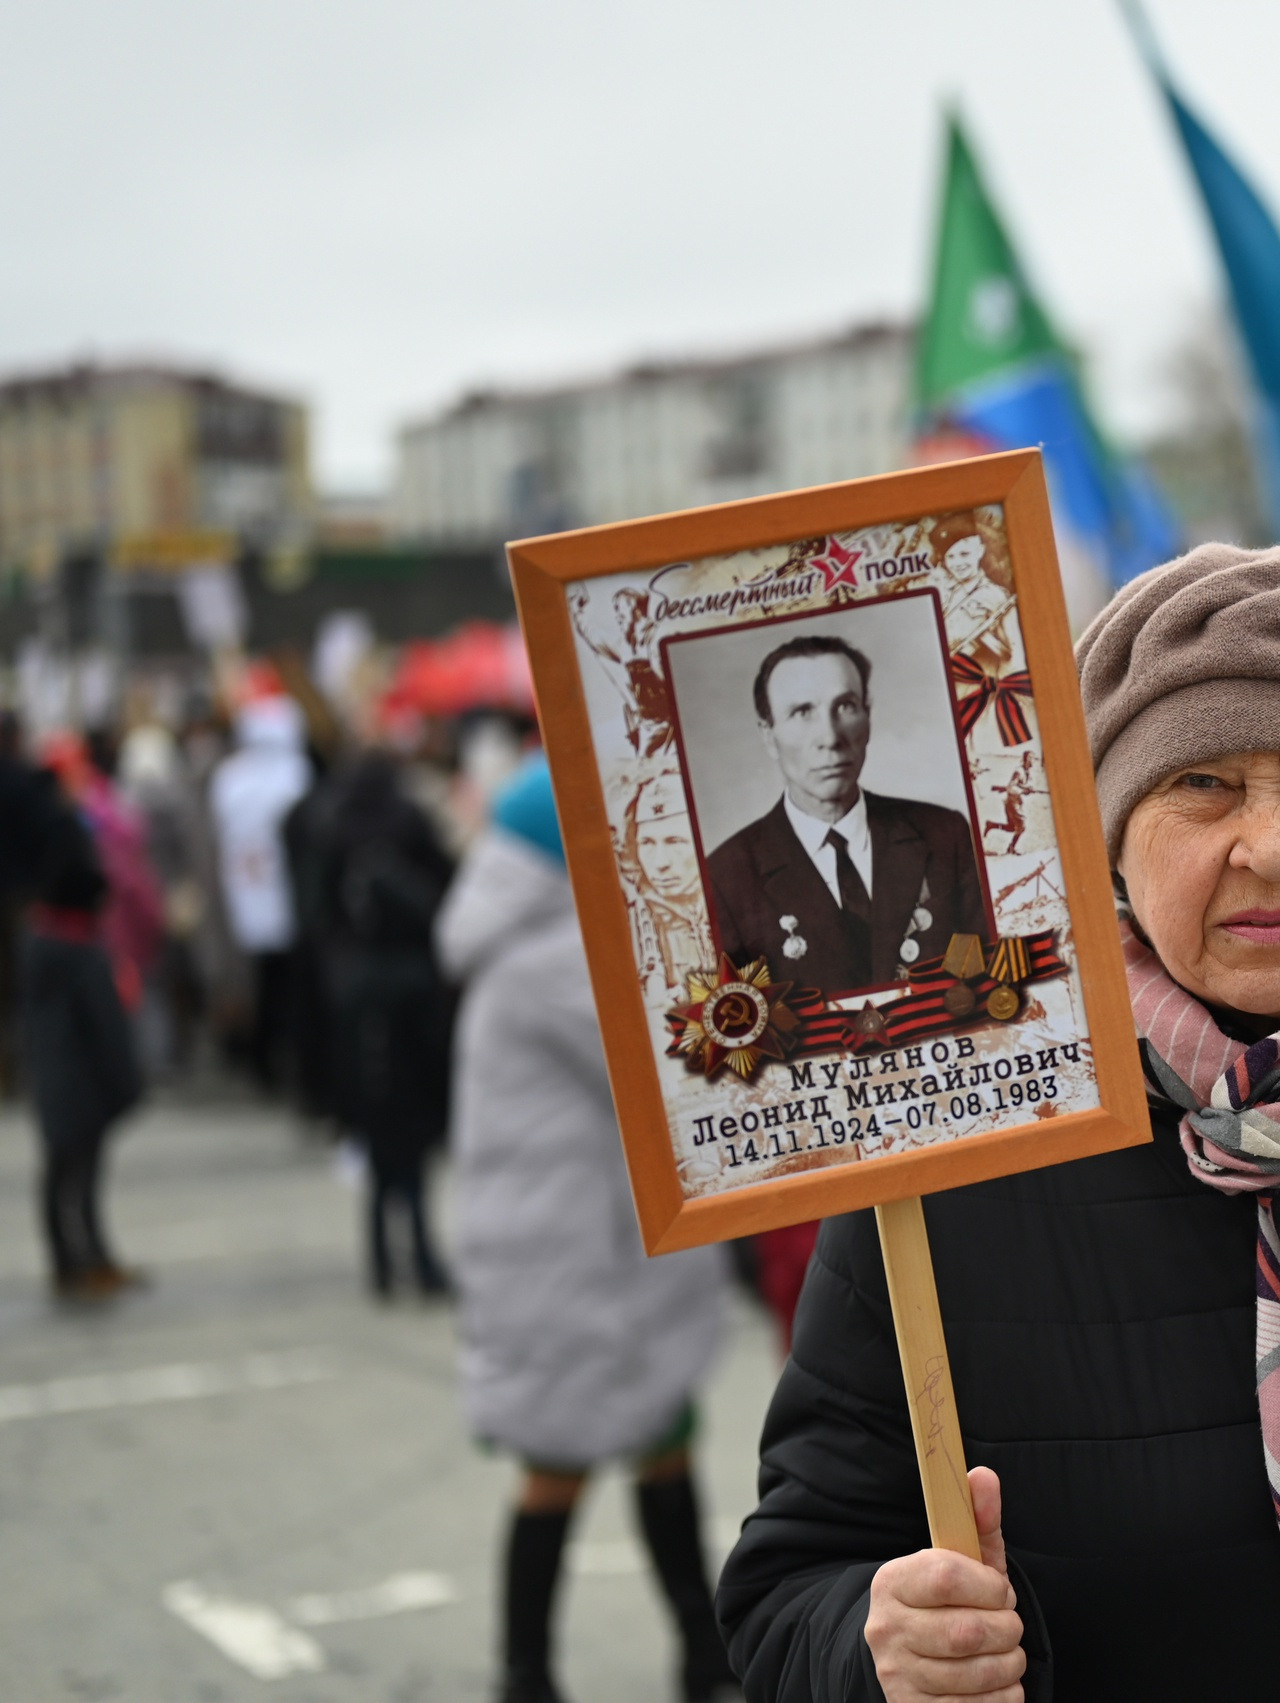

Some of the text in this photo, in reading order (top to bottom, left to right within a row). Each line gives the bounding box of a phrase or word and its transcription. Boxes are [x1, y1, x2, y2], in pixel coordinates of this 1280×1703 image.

[693, 1041, 1082, 1147] Леонид Михайлович
[789, 1036, 976, 1092] Мулянов
